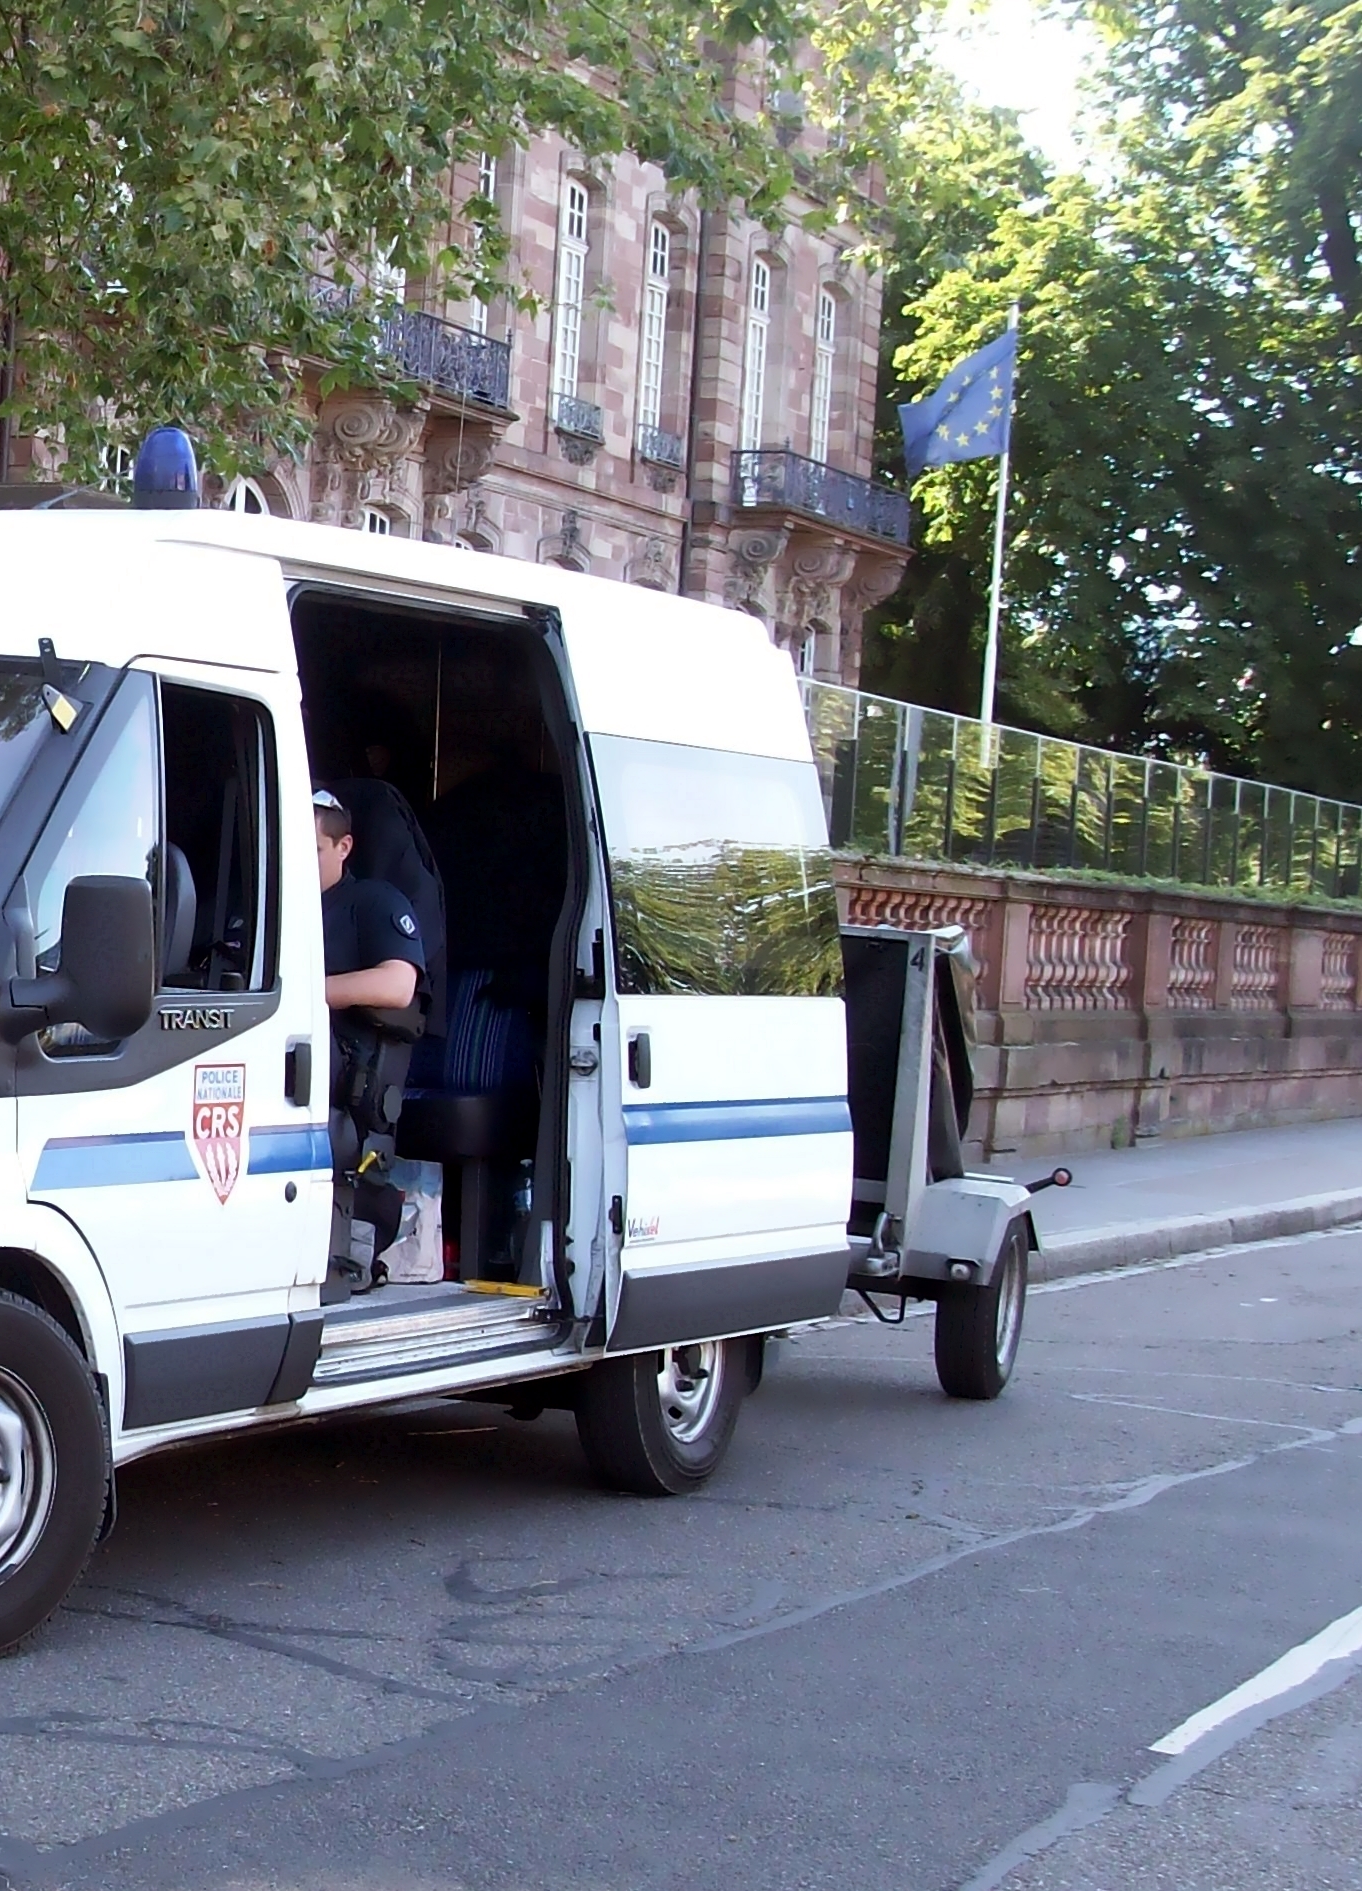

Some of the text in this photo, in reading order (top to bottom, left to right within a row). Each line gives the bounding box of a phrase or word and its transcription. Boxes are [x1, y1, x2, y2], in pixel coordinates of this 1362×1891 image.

[910, 946, 925, 972] 4
[159, 1008, 235, 1030] TRANSIT
[201, 1069, 239, 1085] POLICE
[196, 1085, 242, 1101] NATIONALE
[195, 1105, 240, 1140] CRS
